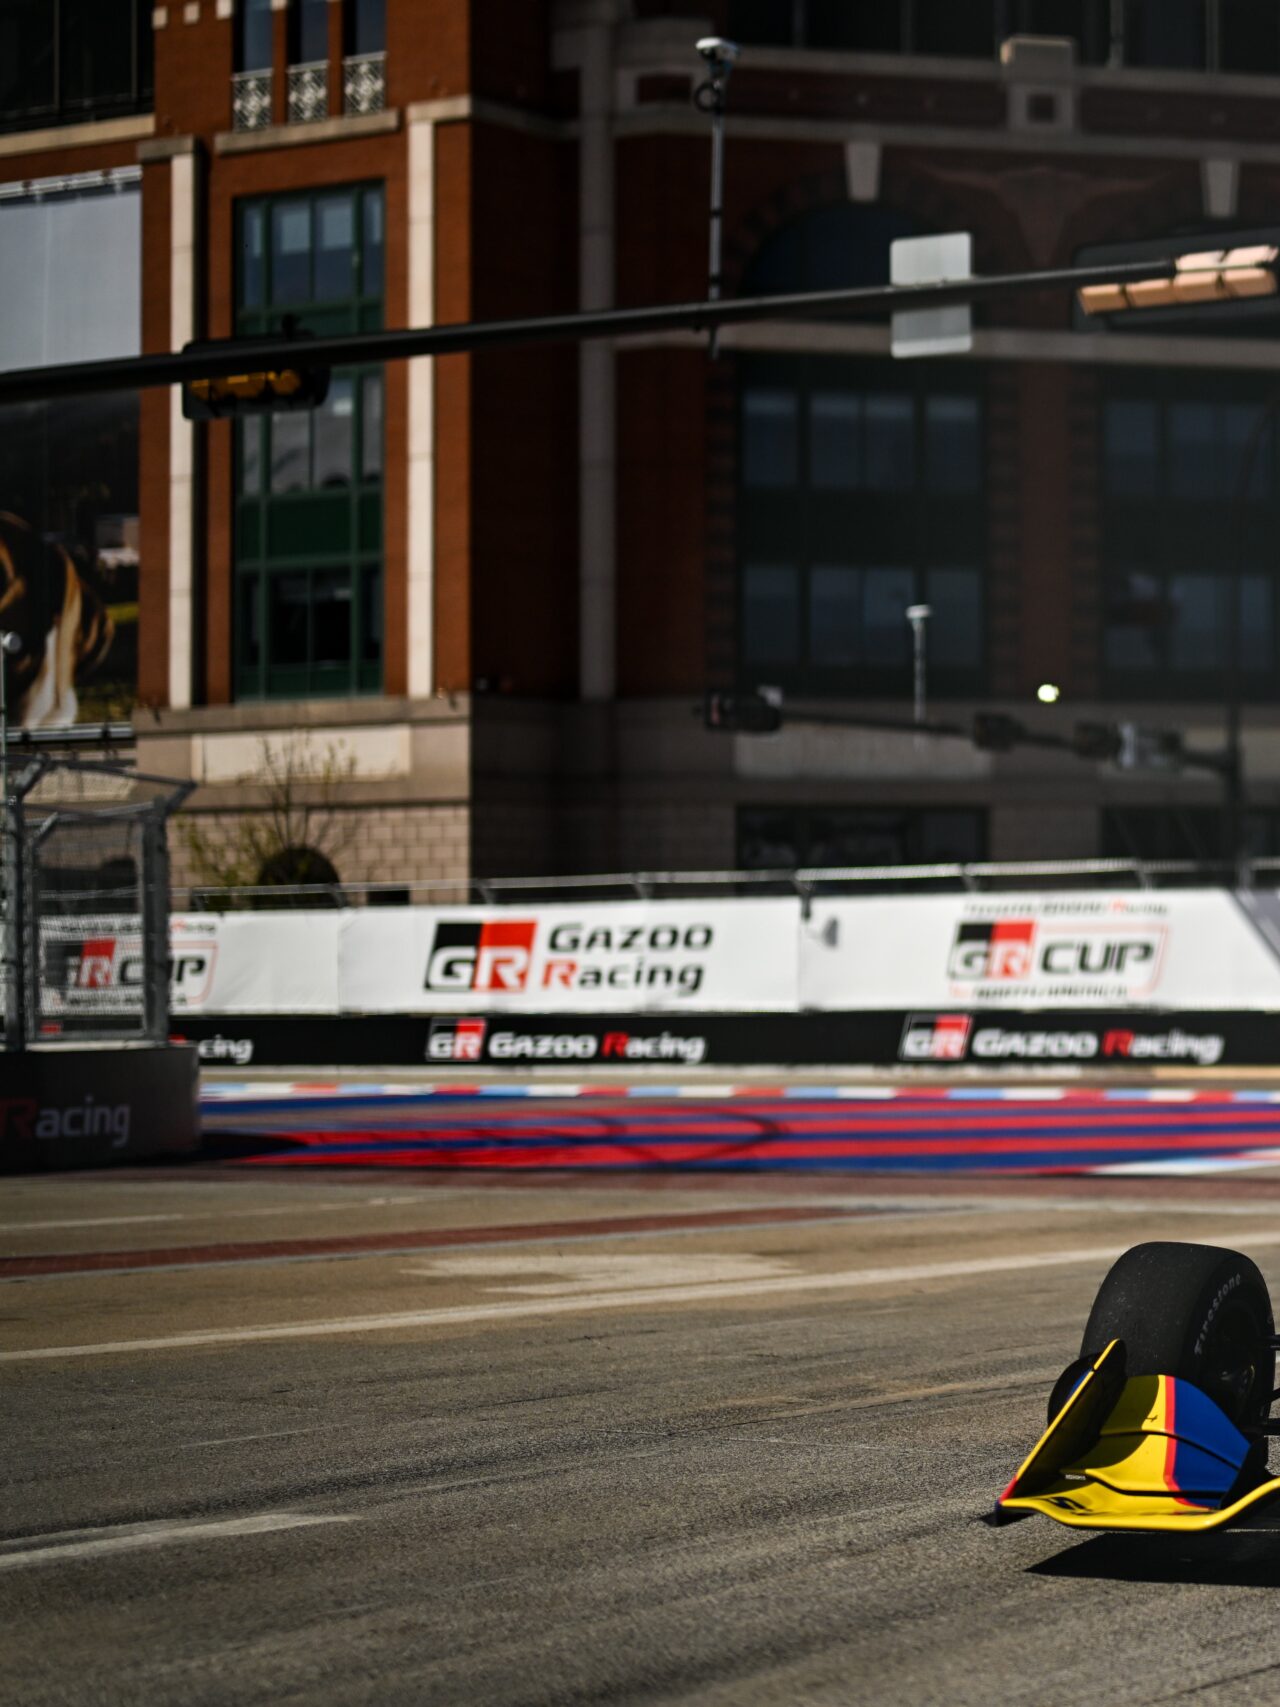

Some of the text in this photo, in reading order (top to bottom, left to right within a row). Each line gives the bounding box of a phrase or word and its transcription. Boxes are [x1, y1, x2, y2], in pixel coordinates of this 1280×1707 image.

[549, 922, 714, 953] GAZOO
[120, 955, 206, 984] CP
[425, 944, 528, 992] GR
[541, 956, 705, 997] Racing
[948, 940, 1155, 980] GR CUP
[488, 1031, 599, 1059] GAZOO
[601, 1030, 706, 1065] Racing
[972, 1028, 1099, 1058] GAZOO
[1102, 1027, 1225, 1066] Racing
